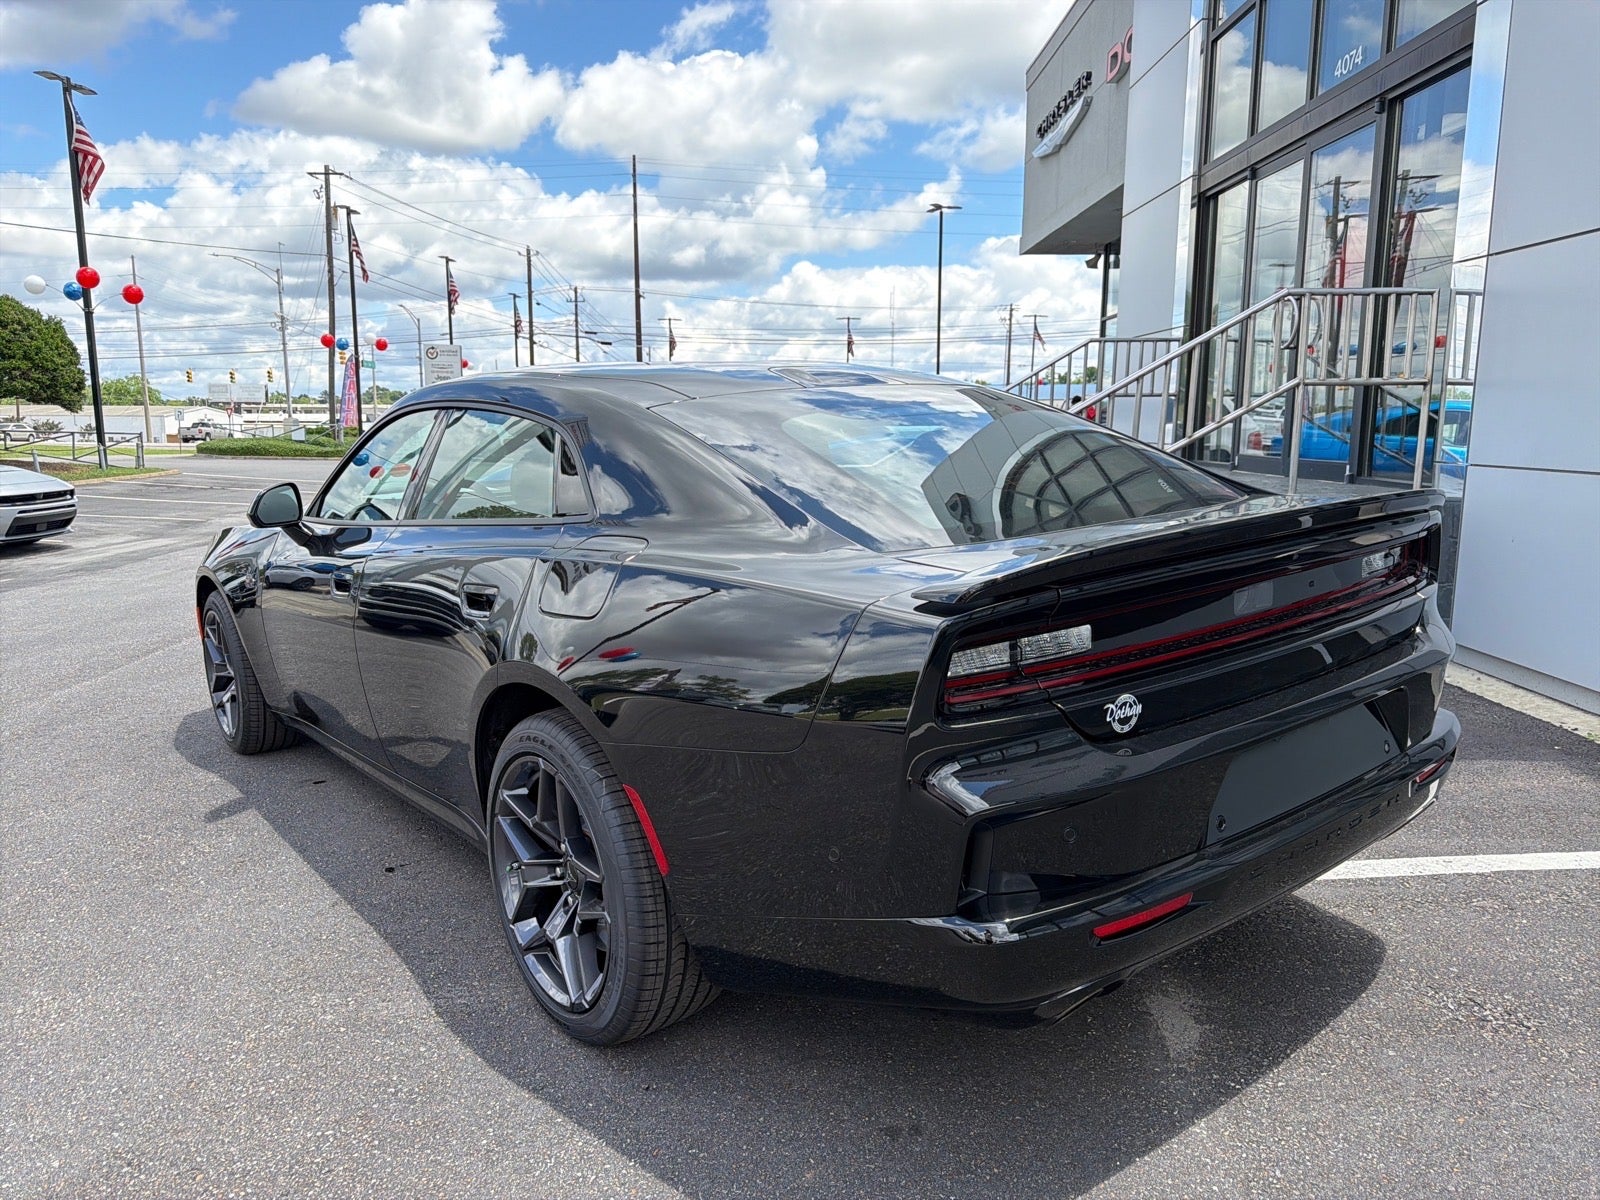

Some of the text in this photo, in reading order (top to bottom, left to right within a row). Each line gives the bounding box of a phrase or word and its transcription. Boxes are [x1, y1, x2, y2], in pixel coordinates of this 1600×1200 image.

[1334, 45, 1362, 78] 4074
[1036, 71, 1092, 139] CHRYSLER
[344, 362, 358, 427] SALE
[1103, 702, 1142, 721] Dothan
[519, 735, 556, 752] EAGLE
